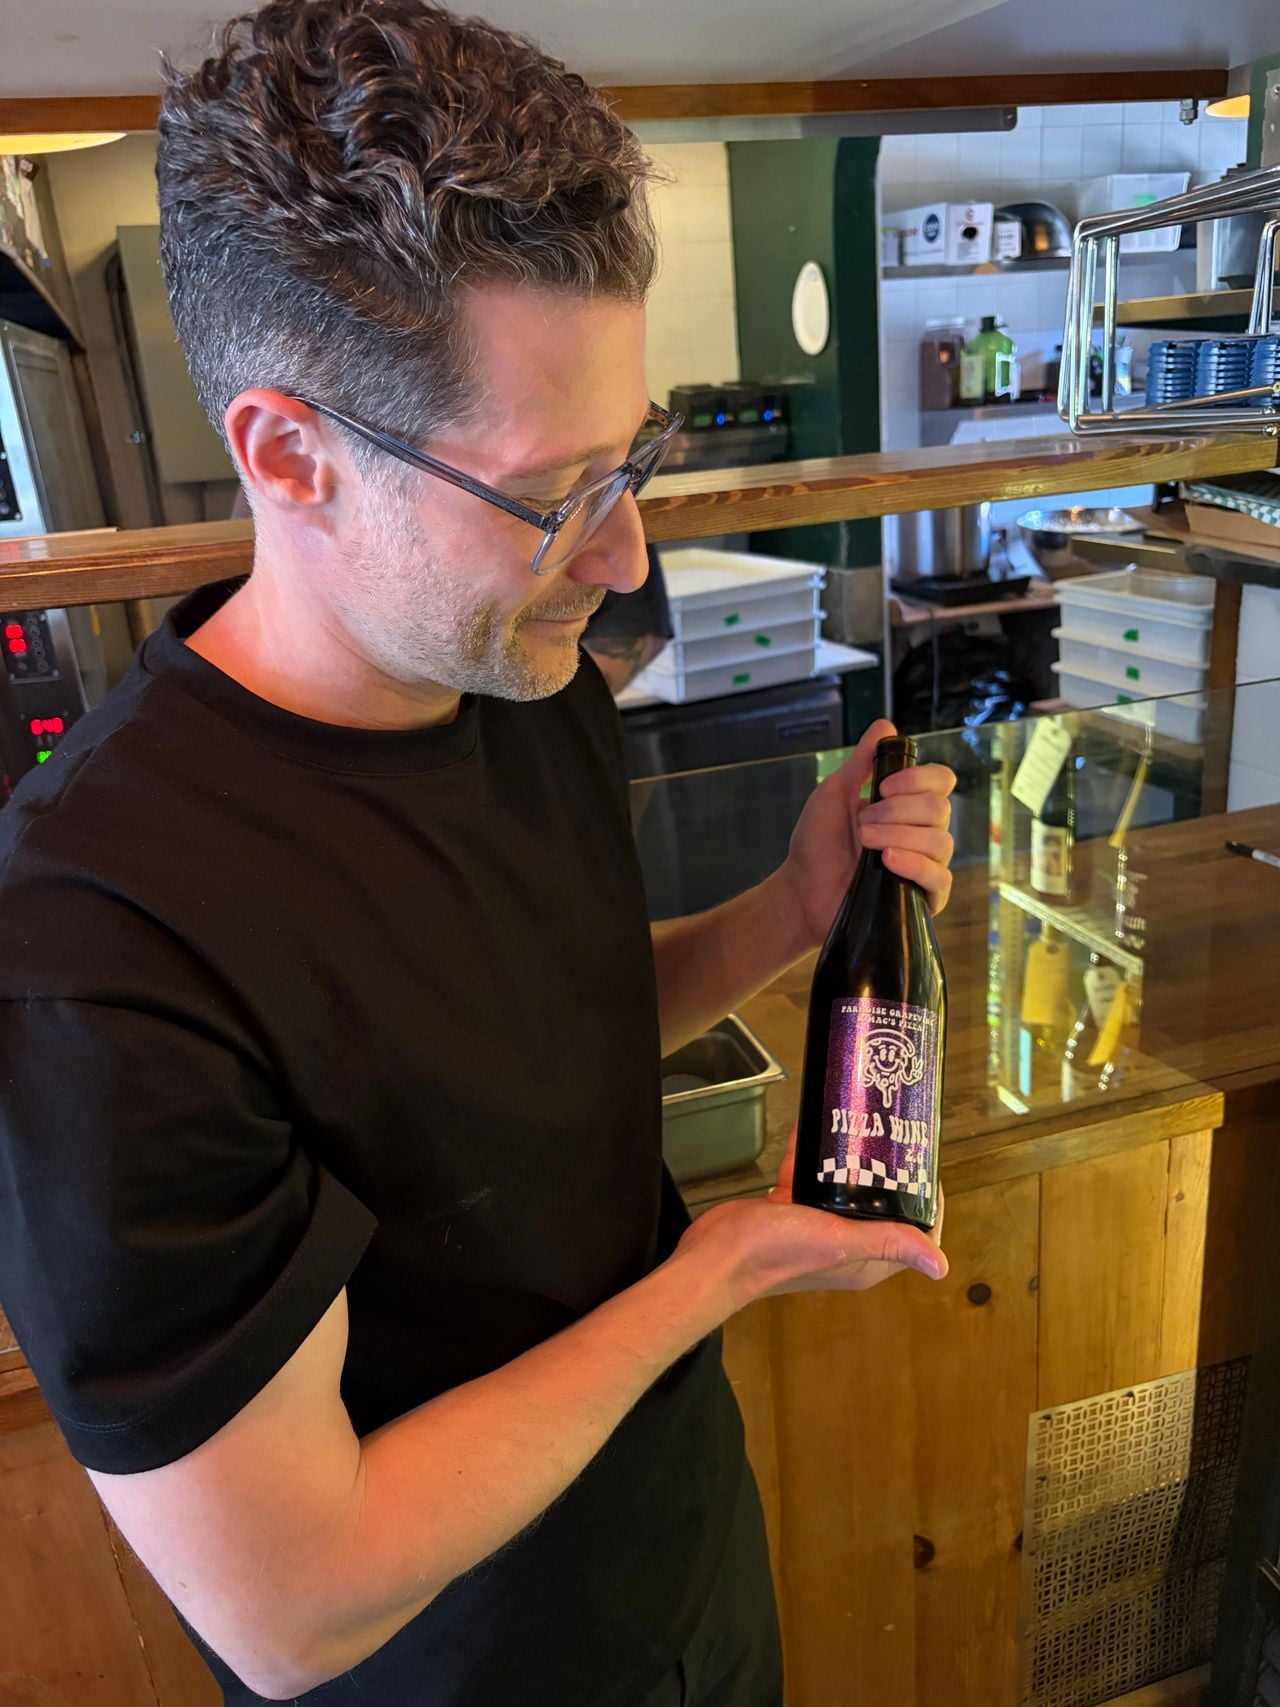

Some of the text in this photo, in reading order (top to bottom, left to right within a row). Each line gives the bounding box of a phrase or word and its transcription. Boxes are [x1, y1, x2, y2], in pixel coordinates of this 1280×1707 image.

[869, 1015, 896, 1026] MAC'S
[898, 1019, 922, 1032] PIZZA
[831, 1108, 929, 1148] PIZZA WINE
